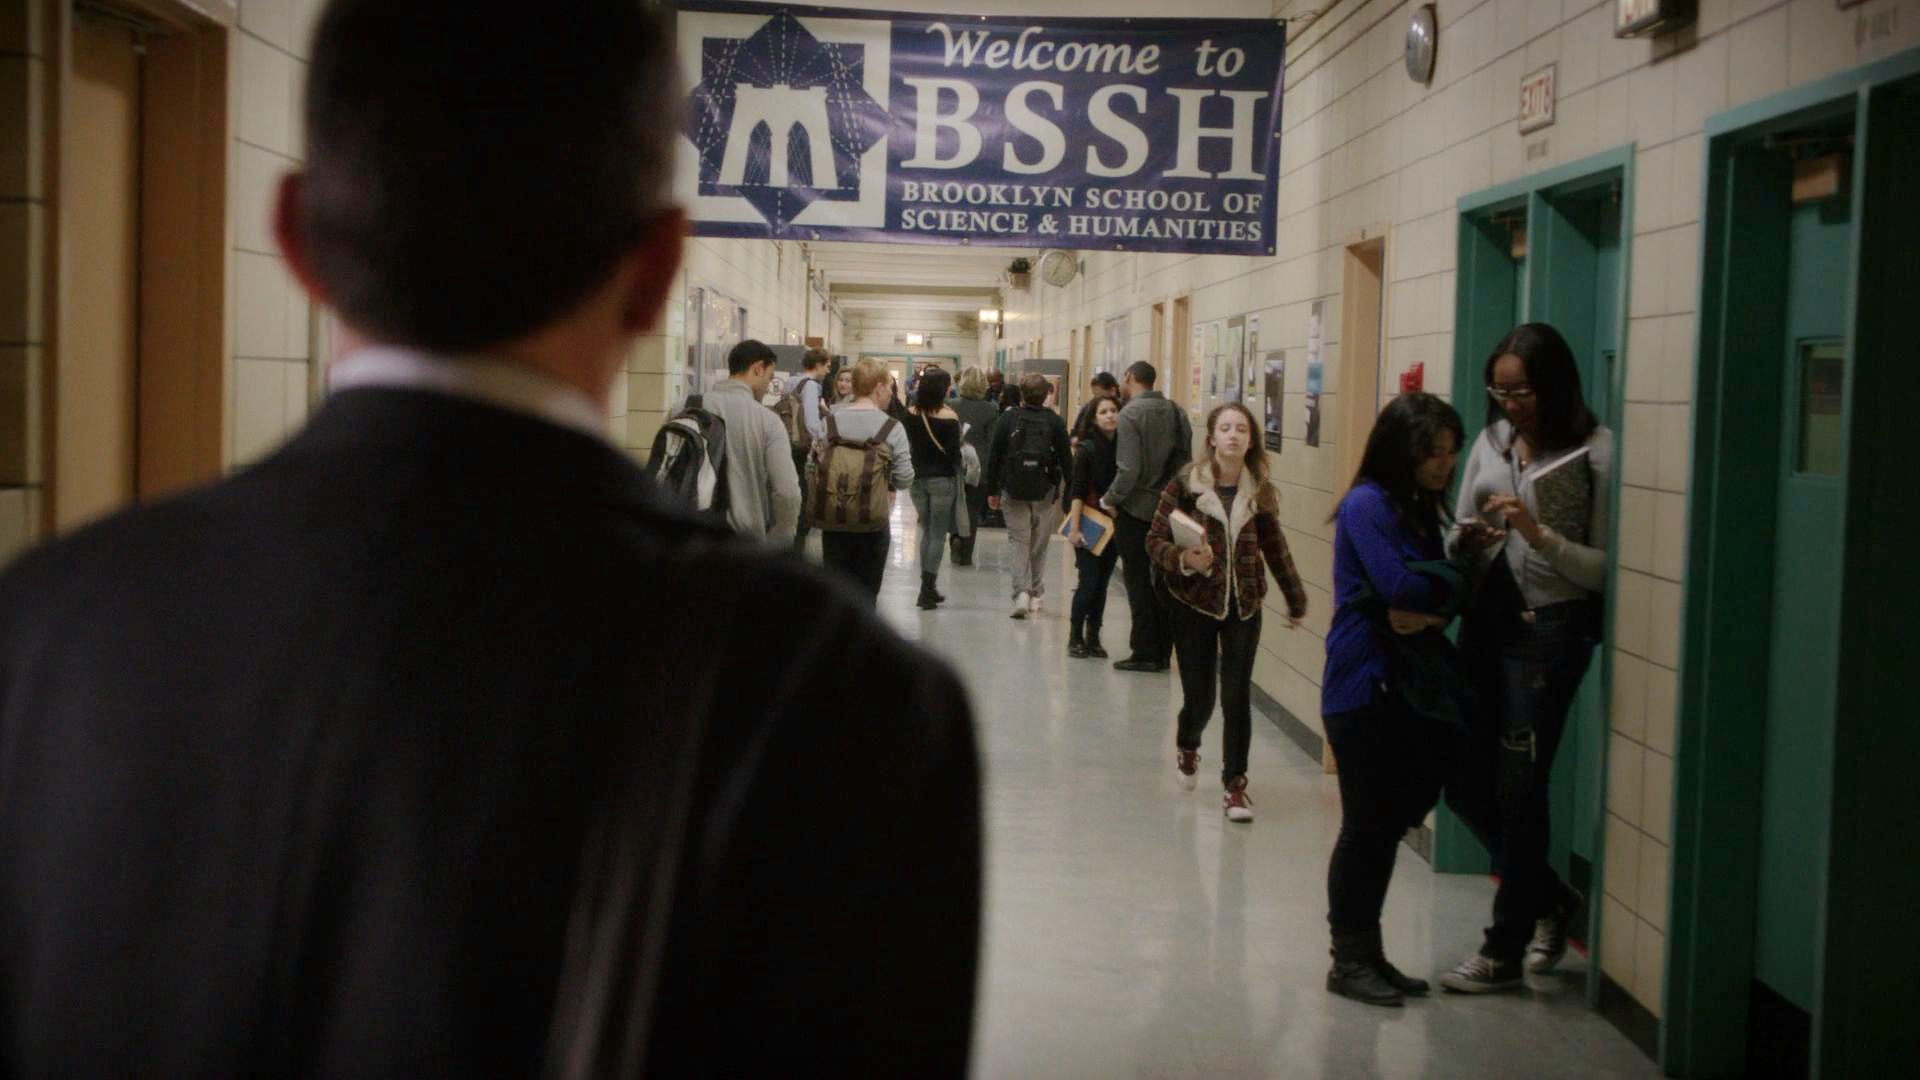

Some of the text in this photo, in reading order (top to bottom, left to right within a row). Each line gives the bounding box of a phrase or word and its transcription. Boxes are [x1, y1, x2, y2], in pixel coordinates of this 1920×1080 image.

[925, 22, 1245, 77] Welcome to
[900, 77, 1268, 181] BSSH
[902, 181, 1263, 214] BROOKLYN SCHOOL OF
[901, 209, 1262, 242] SCIENCE & HUMANITIES
